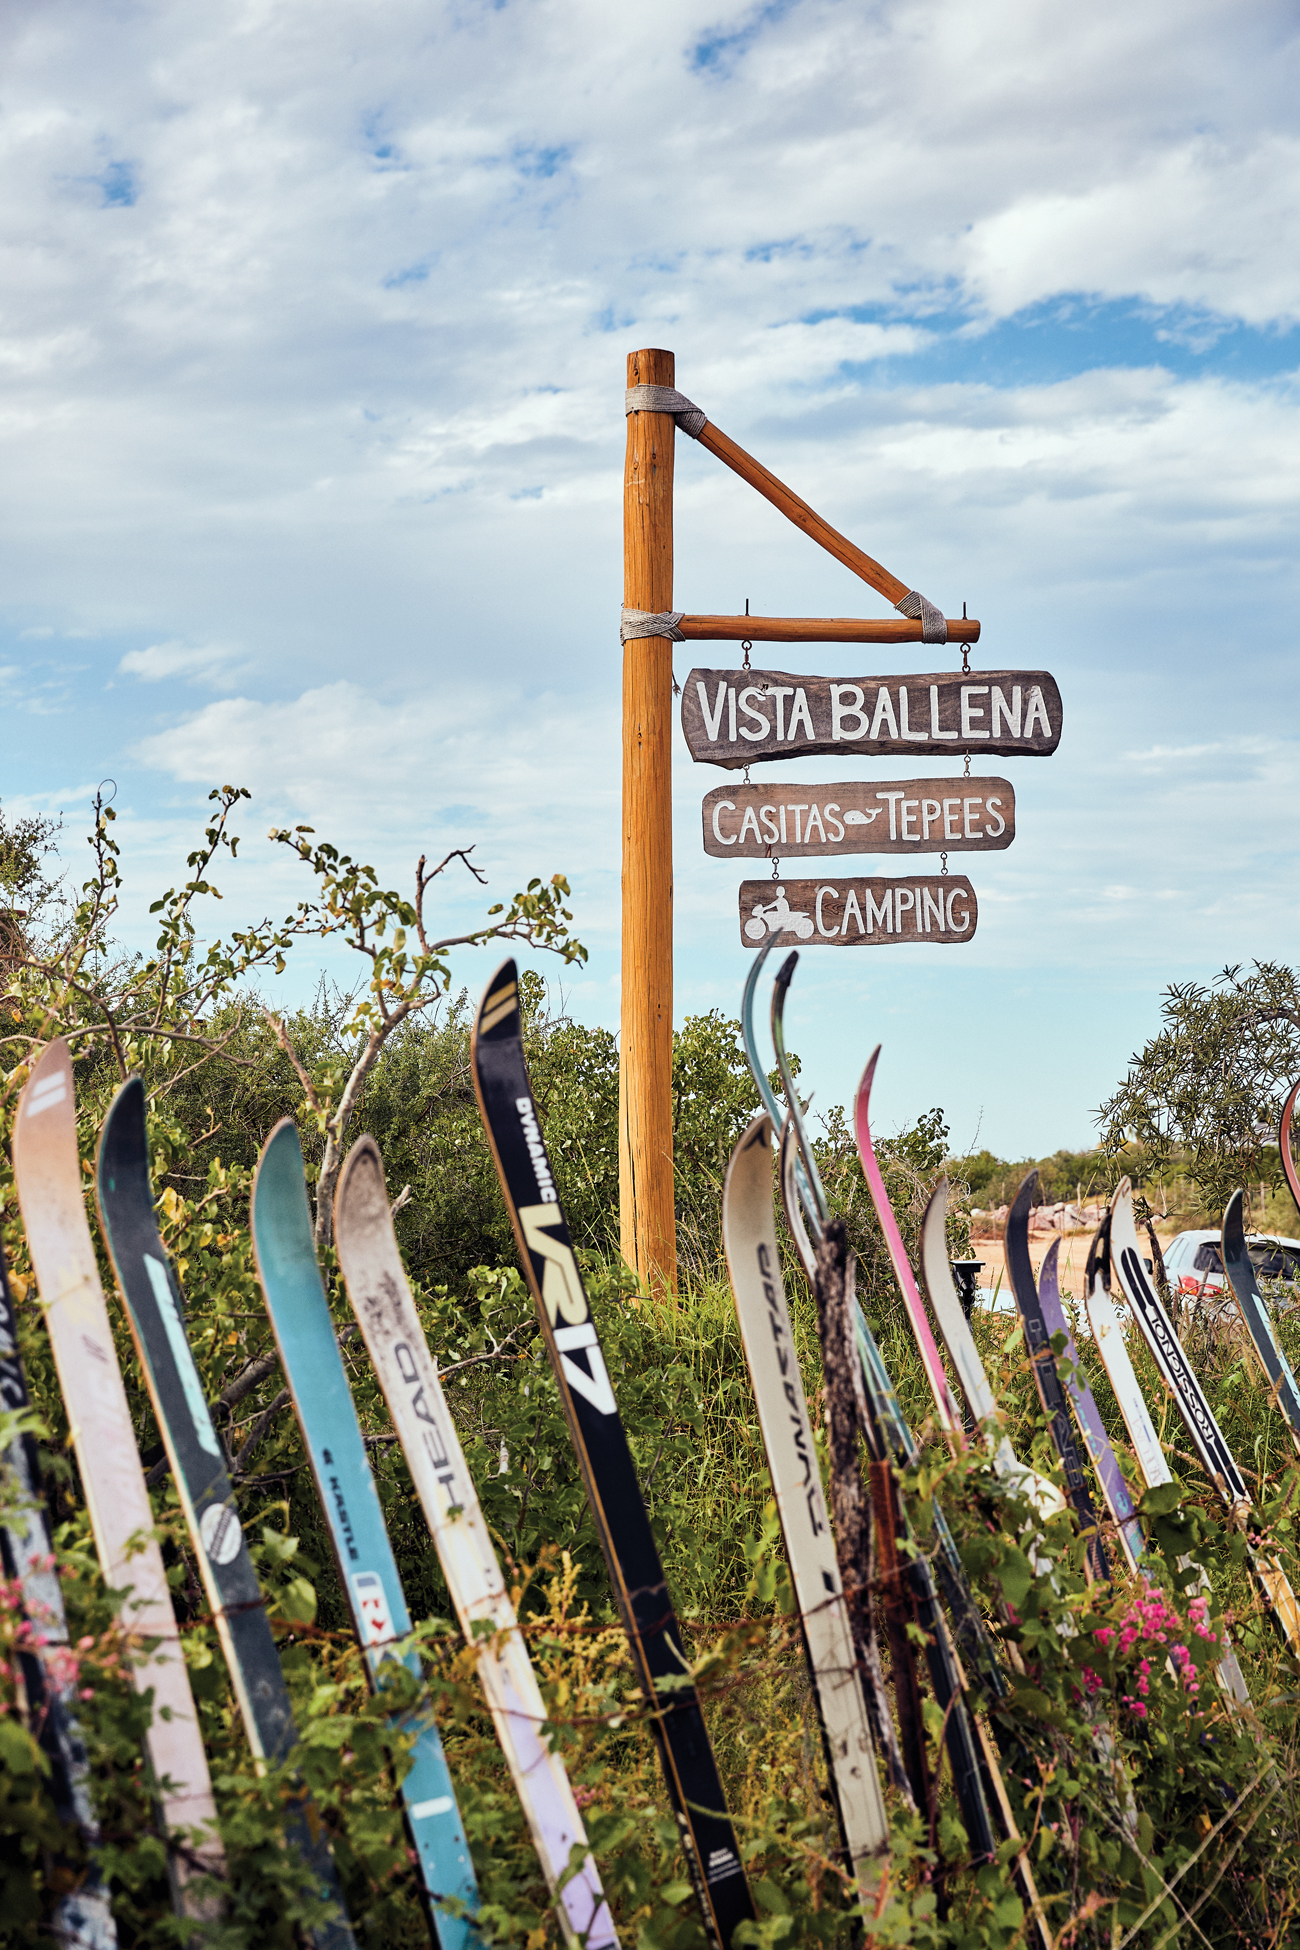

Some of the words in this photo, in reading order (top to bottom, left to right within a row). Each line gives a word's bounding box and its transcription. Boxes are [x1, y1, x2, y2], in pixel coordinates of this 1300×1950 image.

[696, 681, 816, 742] VISTA
[830, 684, 1053, 741] BALLENA
[712, 800, 845, 845] CASITAS
[875, 791, 1006, 841] TEPEES
[815, 885, 970, 937] CAMPING
[515, 1097, 557, 1203] DYNAMIC
[1151, 1317, 1214, 1441] ROSSIGNOL
[394, 1342, 465, 1511] HEAD
